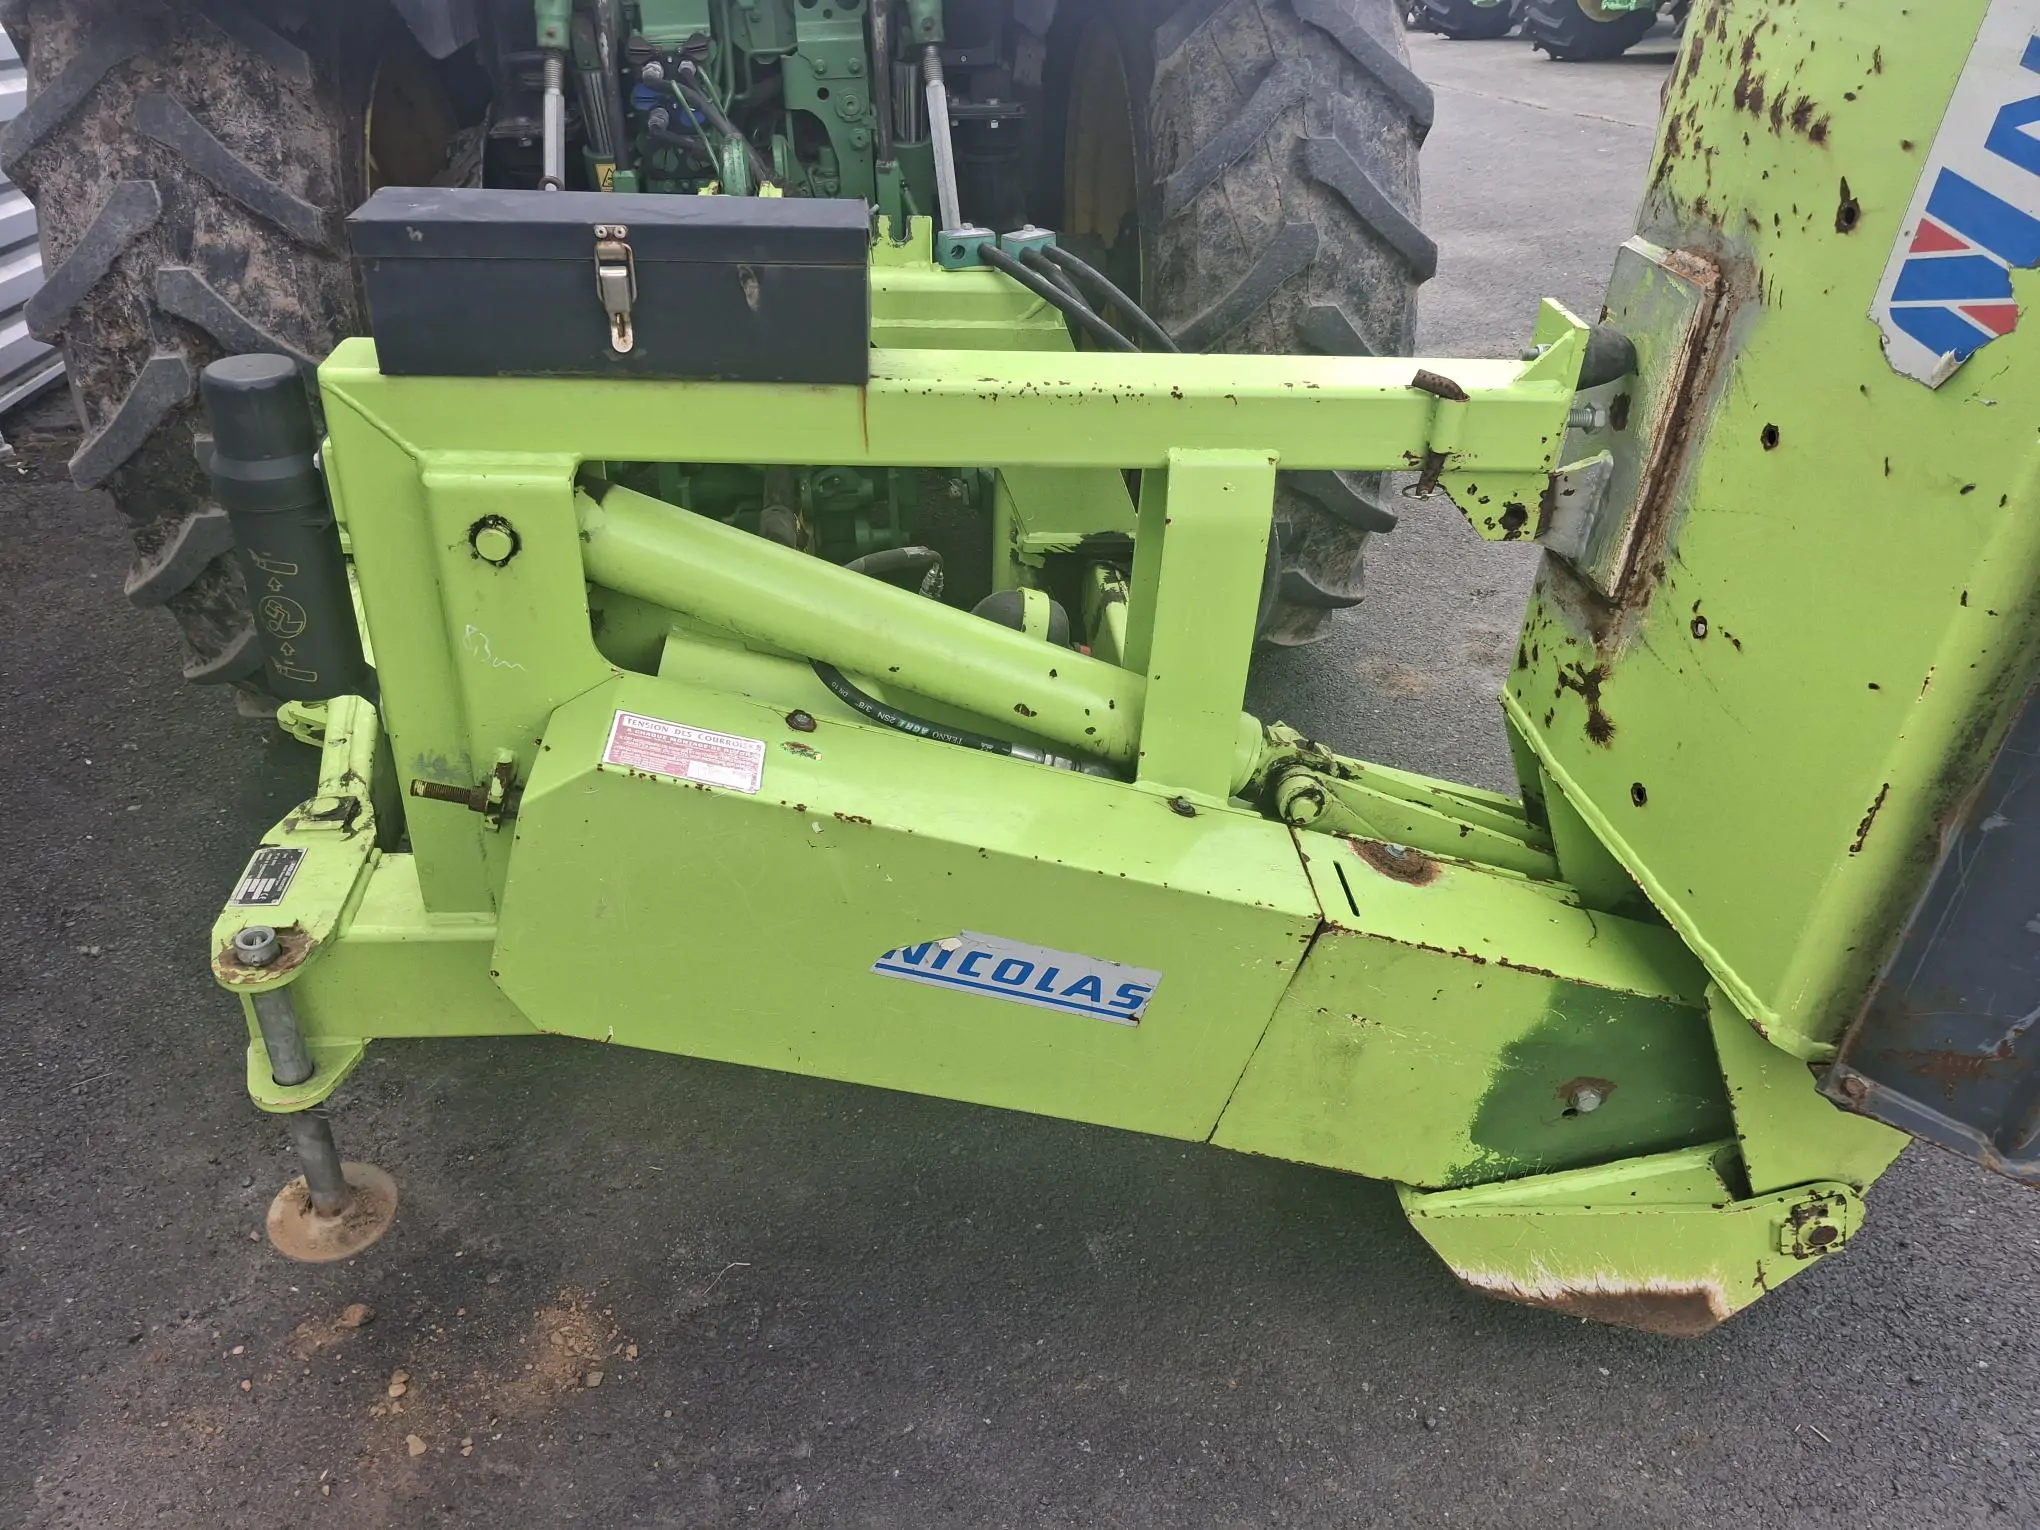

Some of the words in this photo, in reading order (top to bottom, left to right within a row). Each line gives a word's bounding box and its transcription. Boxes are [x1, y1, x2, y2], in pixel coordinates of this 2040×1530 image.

[877, 711, 896, 724] 2SN
[627, 717, 669, 733] TENSION
[674, 728, 692, 738] DES
[898, 719, 930, 735] AGRI
[932, 731, 963, 745] TEKNO
[879, 942, 1152, 1010] NICOLAS
